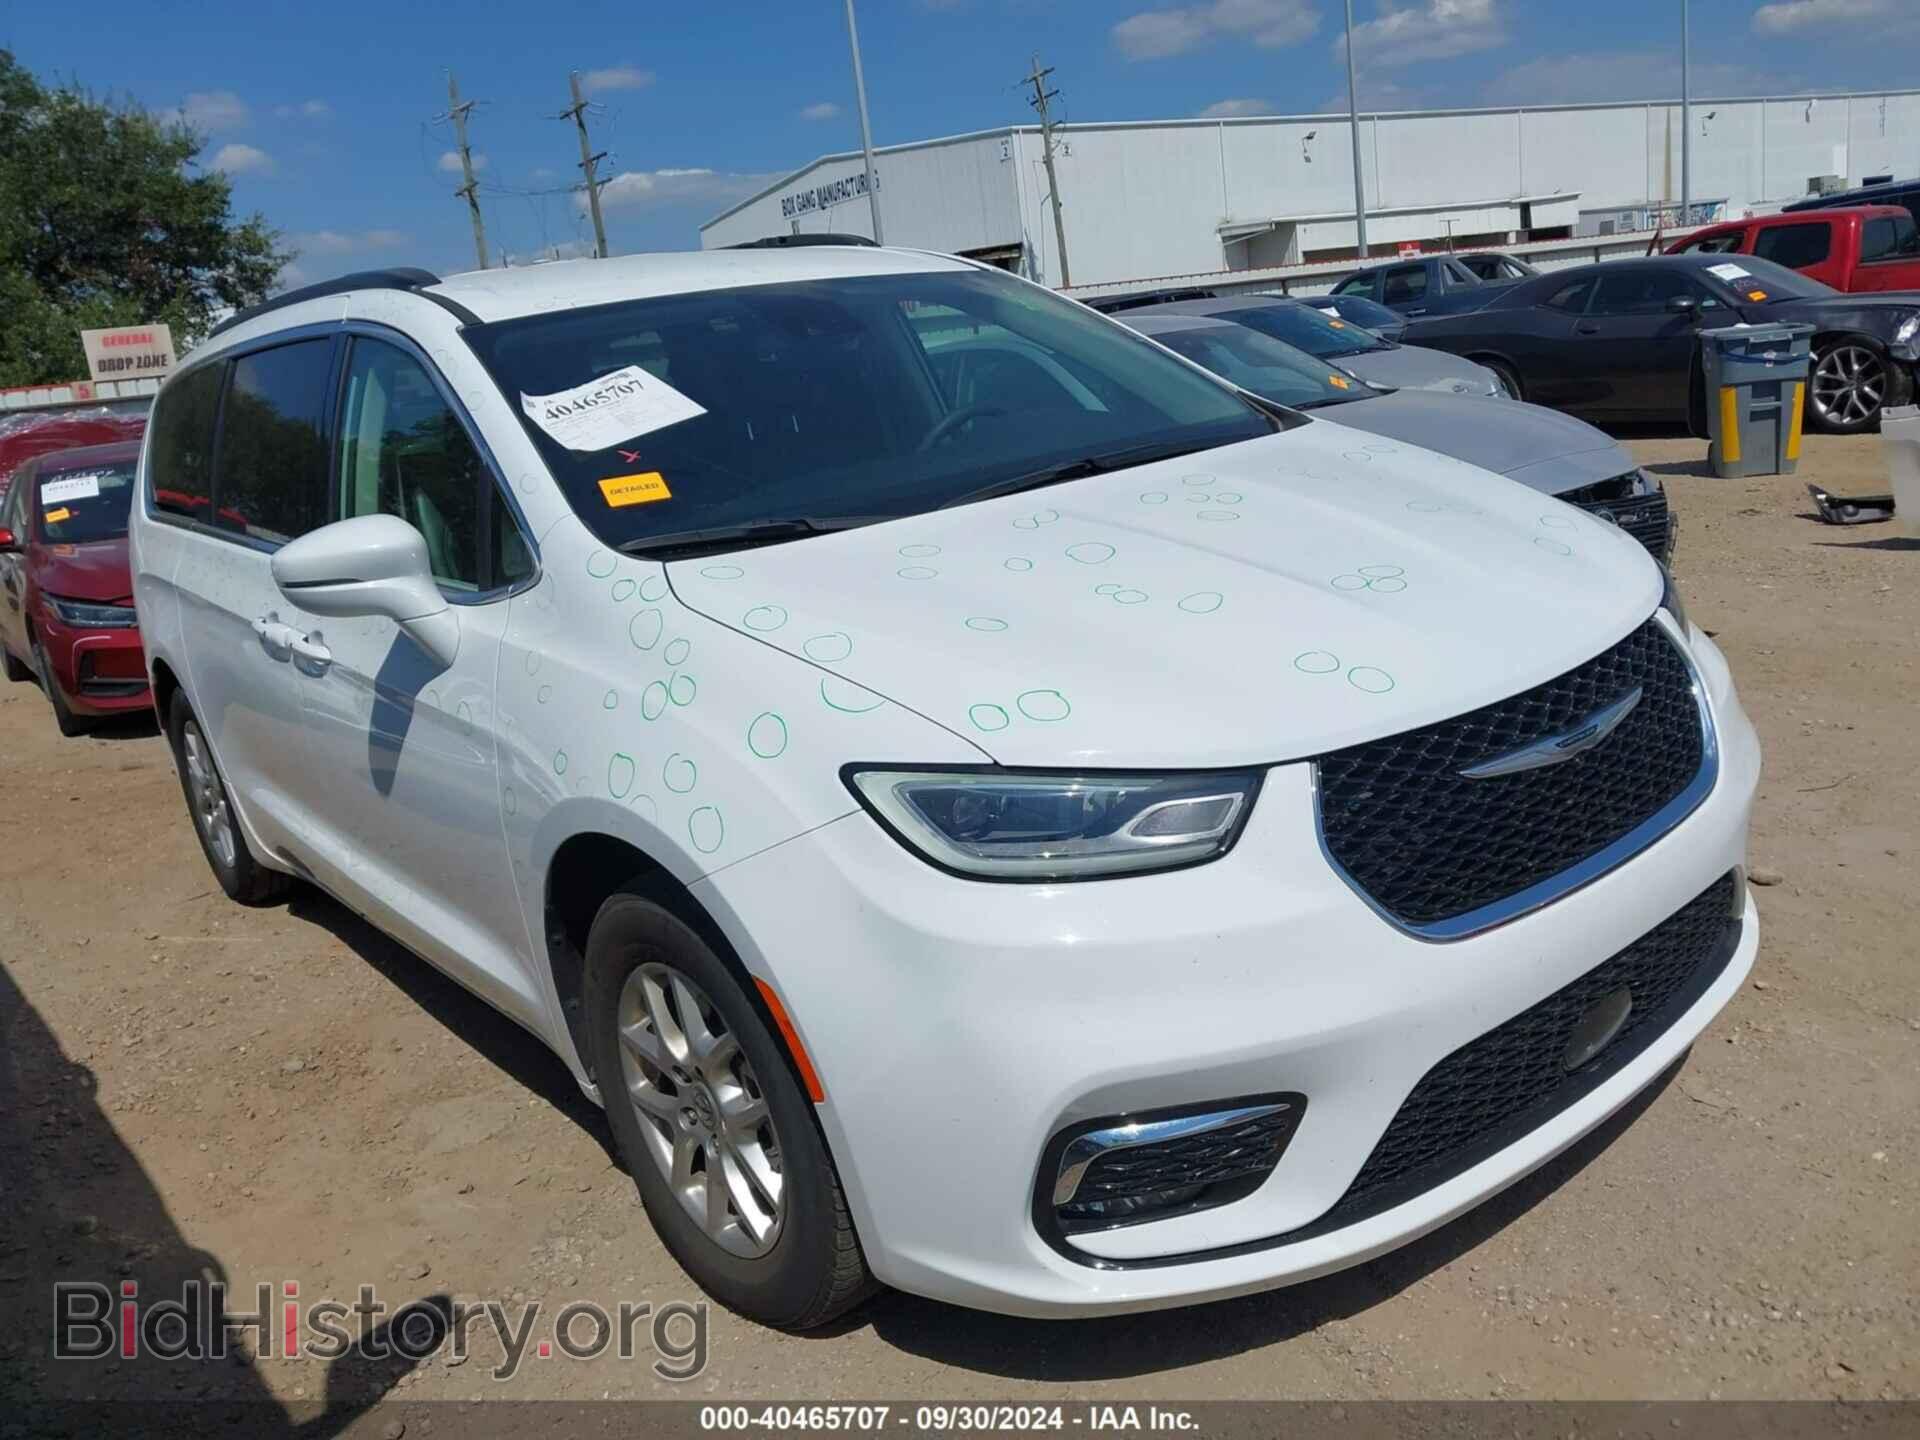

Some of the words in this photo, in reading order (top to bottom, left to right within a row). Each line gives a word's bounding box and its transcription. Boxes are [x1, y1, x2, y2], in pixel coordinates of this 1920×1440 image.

[781, 195, 797, 217] BOX
[98, 357, 134, 373] DROP
[136, 353, 169, 369] ZONE
[544, 379, 645, 420] 40465707
[609, 482, 660, 496] DETAILED
